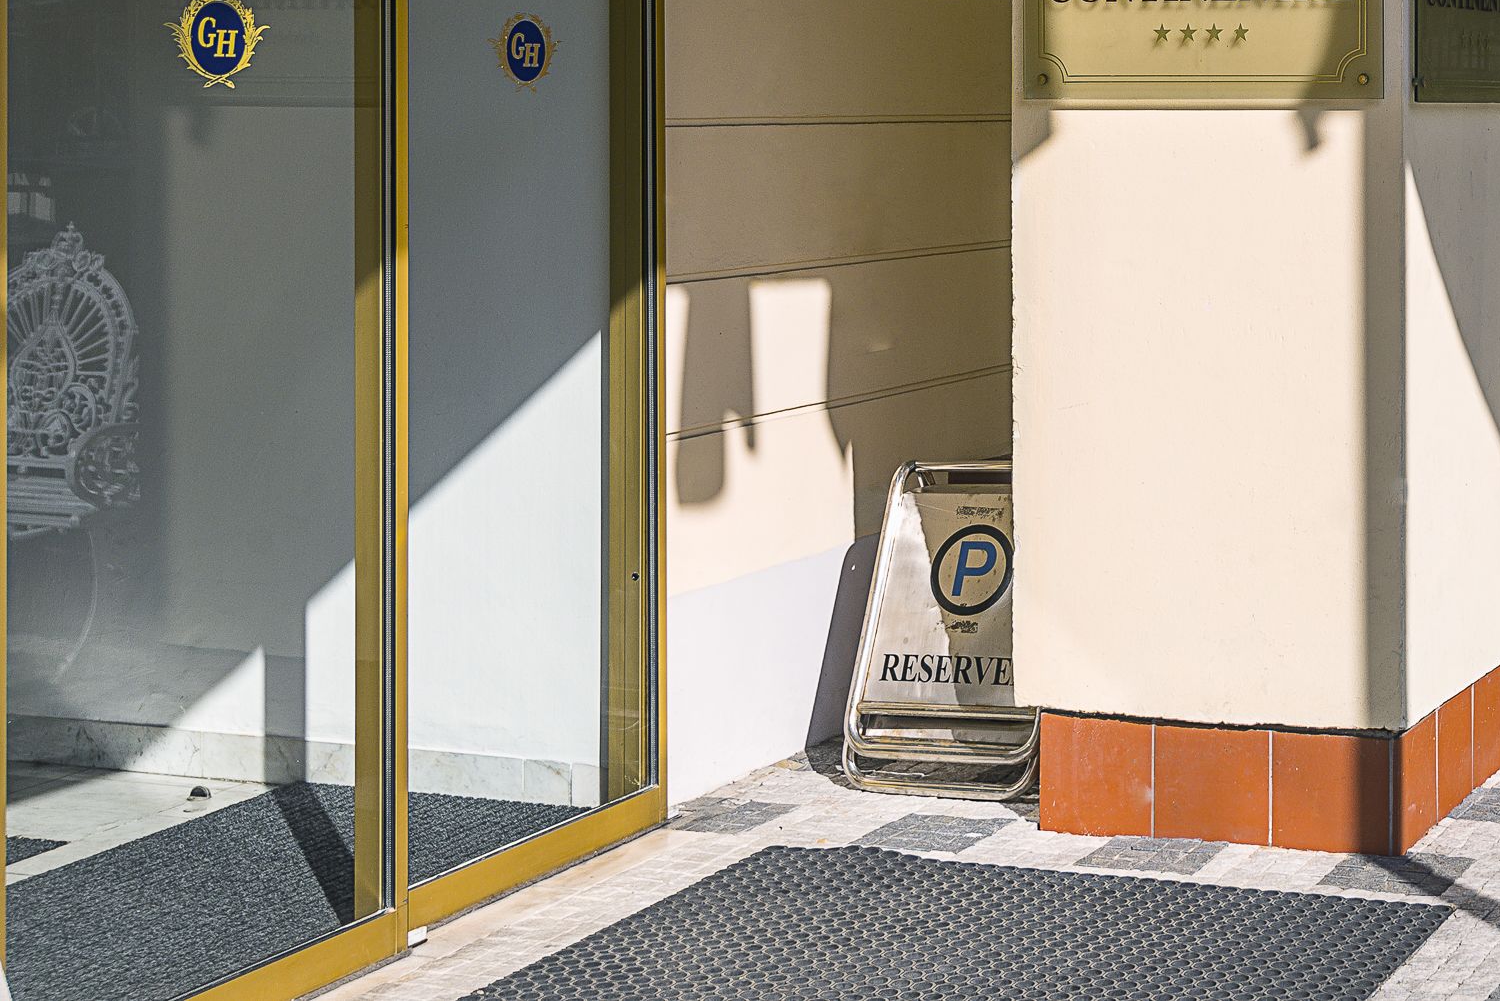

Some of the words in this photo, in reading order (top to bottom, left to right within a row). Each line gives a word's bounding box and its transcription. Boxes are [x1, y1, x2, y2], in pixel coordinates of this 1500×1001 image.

[198, 17, 238, 58] GH
[510, 33, 540, 68] GH
[951, 541, 998, 596] P
[879, 653, 1014, 686] RESERVE
